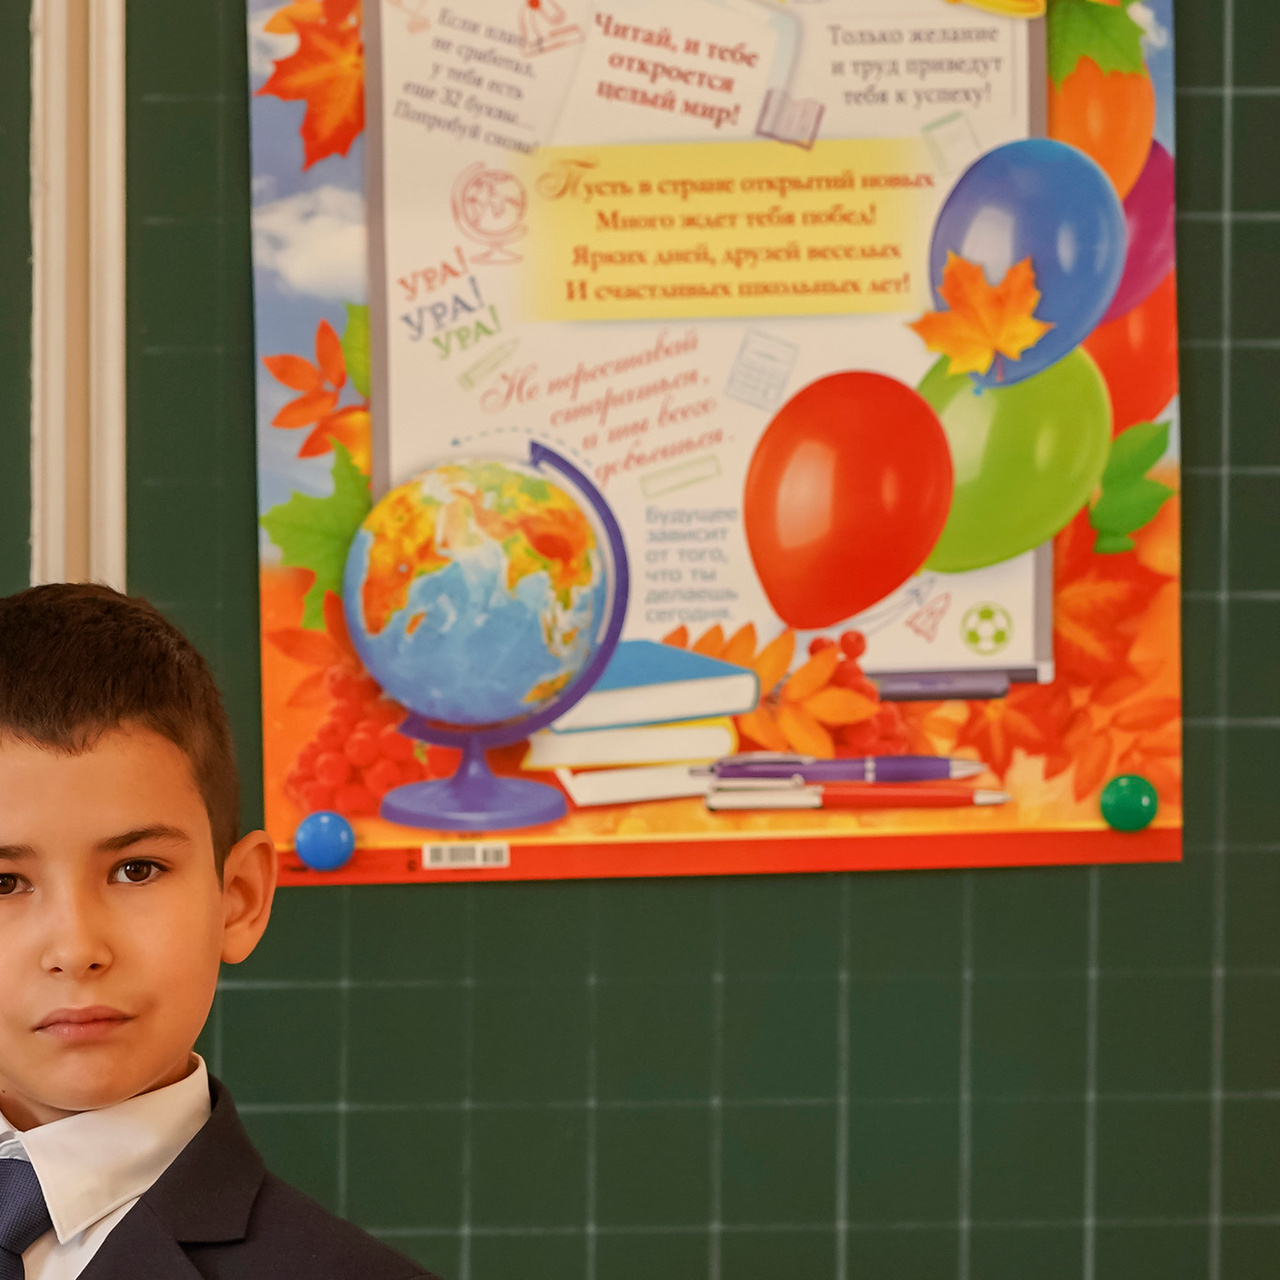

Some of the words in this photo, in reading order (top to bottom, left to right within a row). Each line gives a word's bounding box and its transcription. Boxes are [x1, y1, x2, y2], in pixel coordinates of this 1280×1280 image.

[431, 36, 453, 54] не
[594, 12, 678, 53] Читай,
[683, 40, 700, 55] и
[708, 41, 759, 68] тебе
[827, 24, 904, 46] Только
[909, 25, 1000, 44] желание
[430, 62, 440, 80] у
[447, 65, 483, 88] тебя
[487, 79, 523, 100] есть
[608, 52, 734, 94] откроется
[831, 60, 844, 74] и
[851, 58, 899, 80] труд
[905, 56, 1002, 81] приведут
[595, 80, 676, 111] целый
[680, 99, 741, 129] мир!
[843, 84, 888, 106] тебя
[896, 88, 907, 104] к
[913, 82, 992, 108] успеху!
[534, 159, 633, 203] Пусть
[639, 181, 653, 196] в
[657, 178, 735, 201] стране
[740, 169, 855, 199] открытий
[861, 173, 934, 190] новых
[596, 209, 675, 232] Много
[681, 211, 738, 231] ждет
[745, 205, 796, 228] тебя
[802, 203, 877, 229] побед!
[572, 245, 647, 272] Ярких
[653, 243, 716, 267] дней,
[722, 241, 800, 270] друзей
[807, 243, 901, 263] веселых
[397, 246, 469, 301] УРА!
[566, 281, 587, 301] И
[594, 282, 731, 302] счастливых
[738, 279, 862, 299] школьных
[867, 272, 911, 295] лет!
[402, 275, 484, 342] УРА!
[432, 304, 501, 360] УРА!
[479, 362, 540, 414] Не
[645, 506, 738, 525] Будущее
[647, 528, 728, 542] зависит
[645, 550, 669, 563] от
[678, 549, 728, 564] того,
[645, 569, 683, 582] что
[690, 569, 717, 582] ты
[645, 589, 738, 605] делаешь
[645, 608, 735, 623] сегодня.
